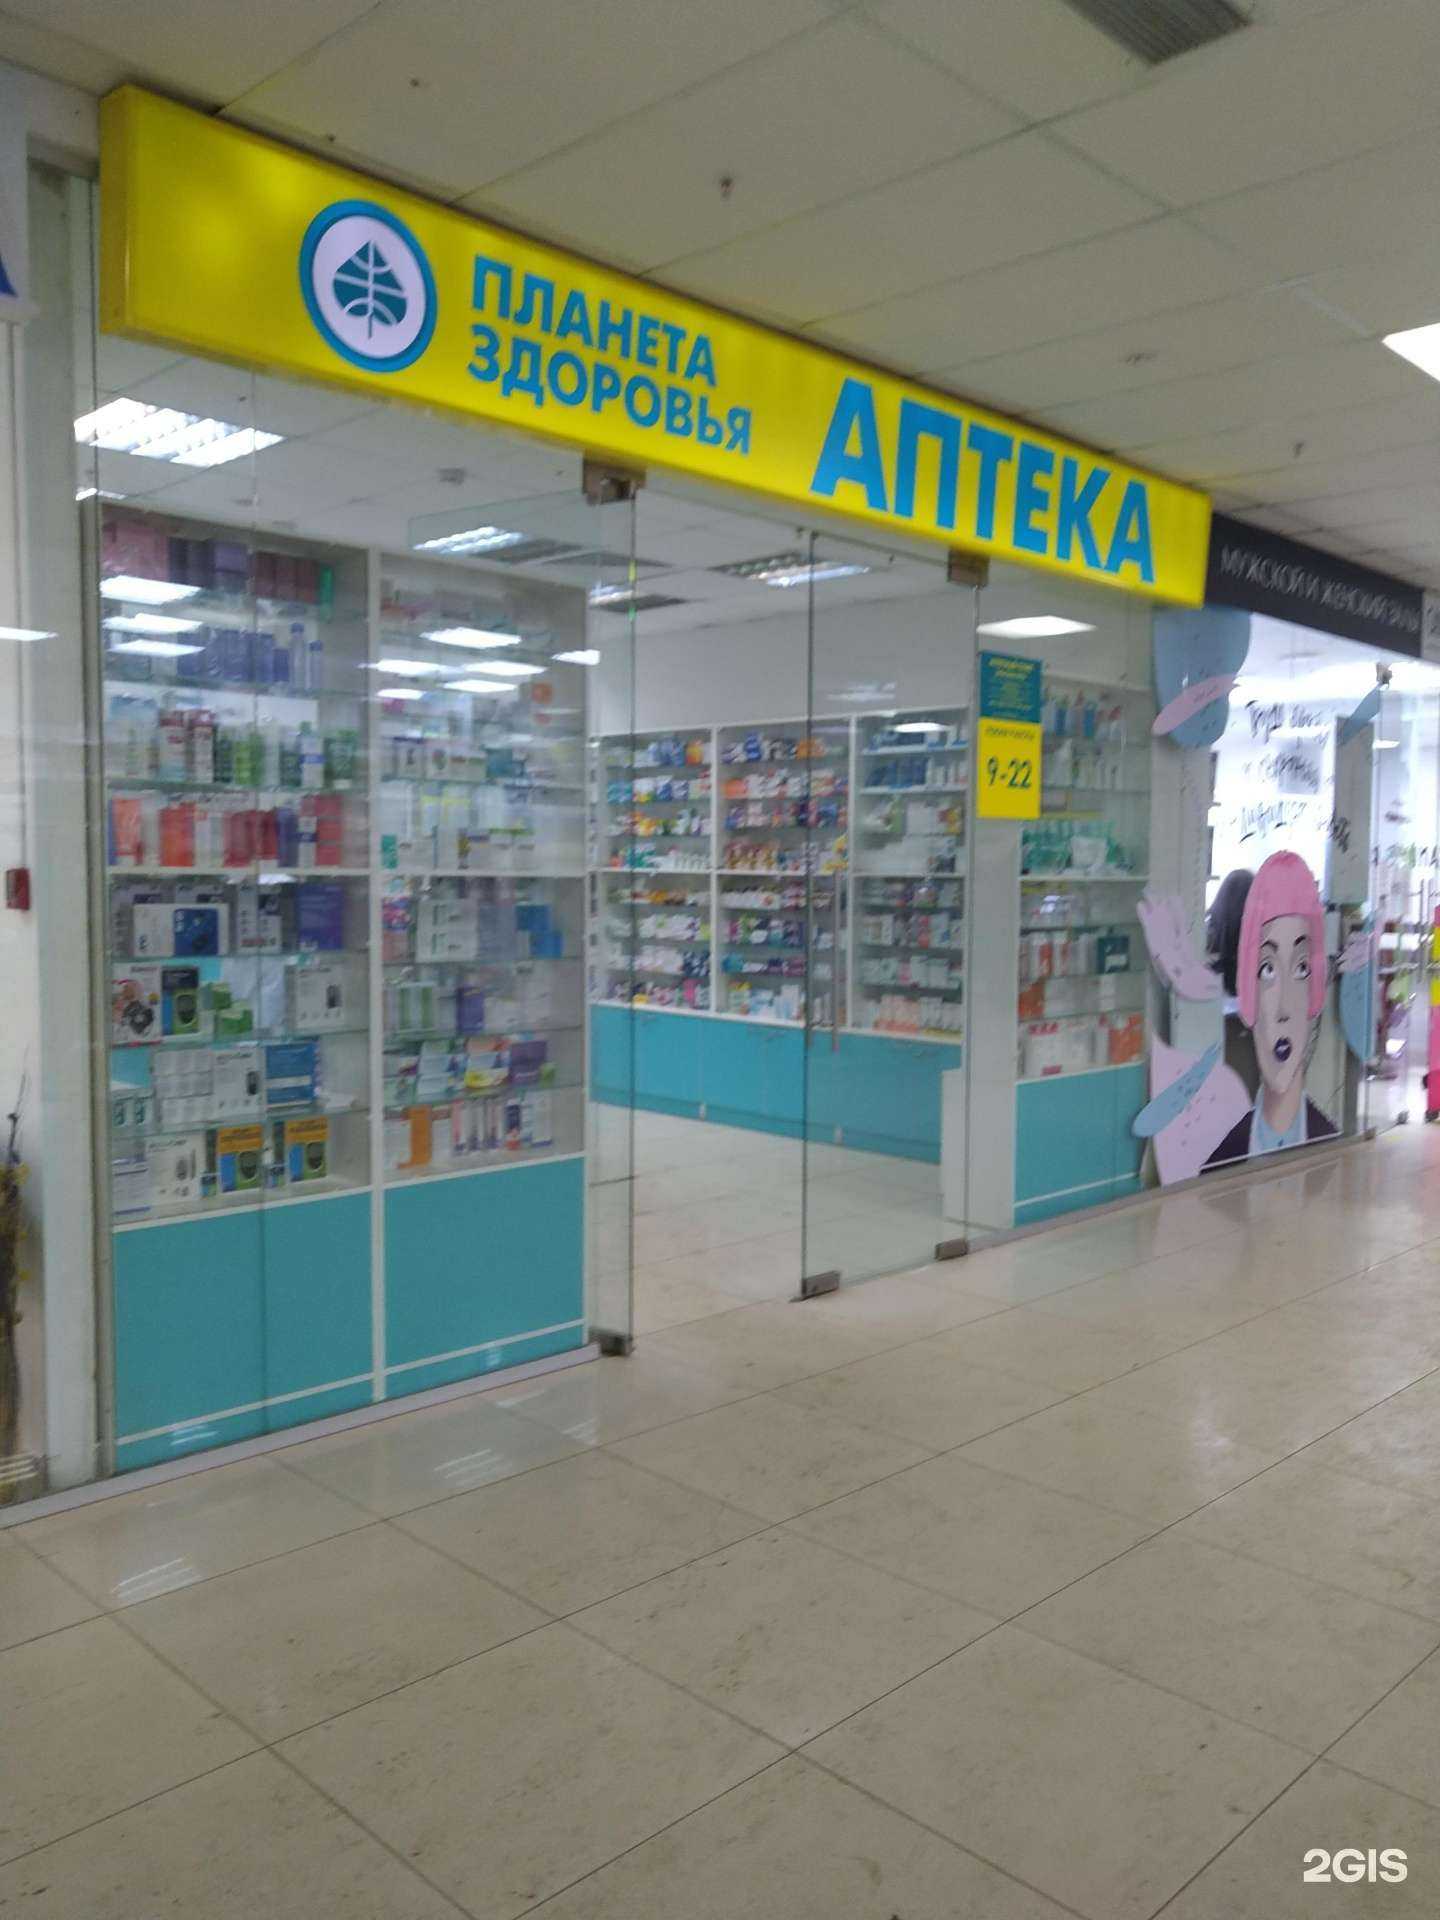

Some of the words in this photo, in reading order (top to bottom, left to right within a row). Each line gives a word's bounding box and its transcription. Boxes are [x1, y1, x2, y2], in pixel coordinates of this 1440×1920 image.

[472, 253, 717, 387] ПЛАНЕТА
[467, 324, 752, 455] ЗДОРОВЬЯ
[810, 377, 1155, 583] АПТЕКА
[986, 756, 1032, 789] 9-22
